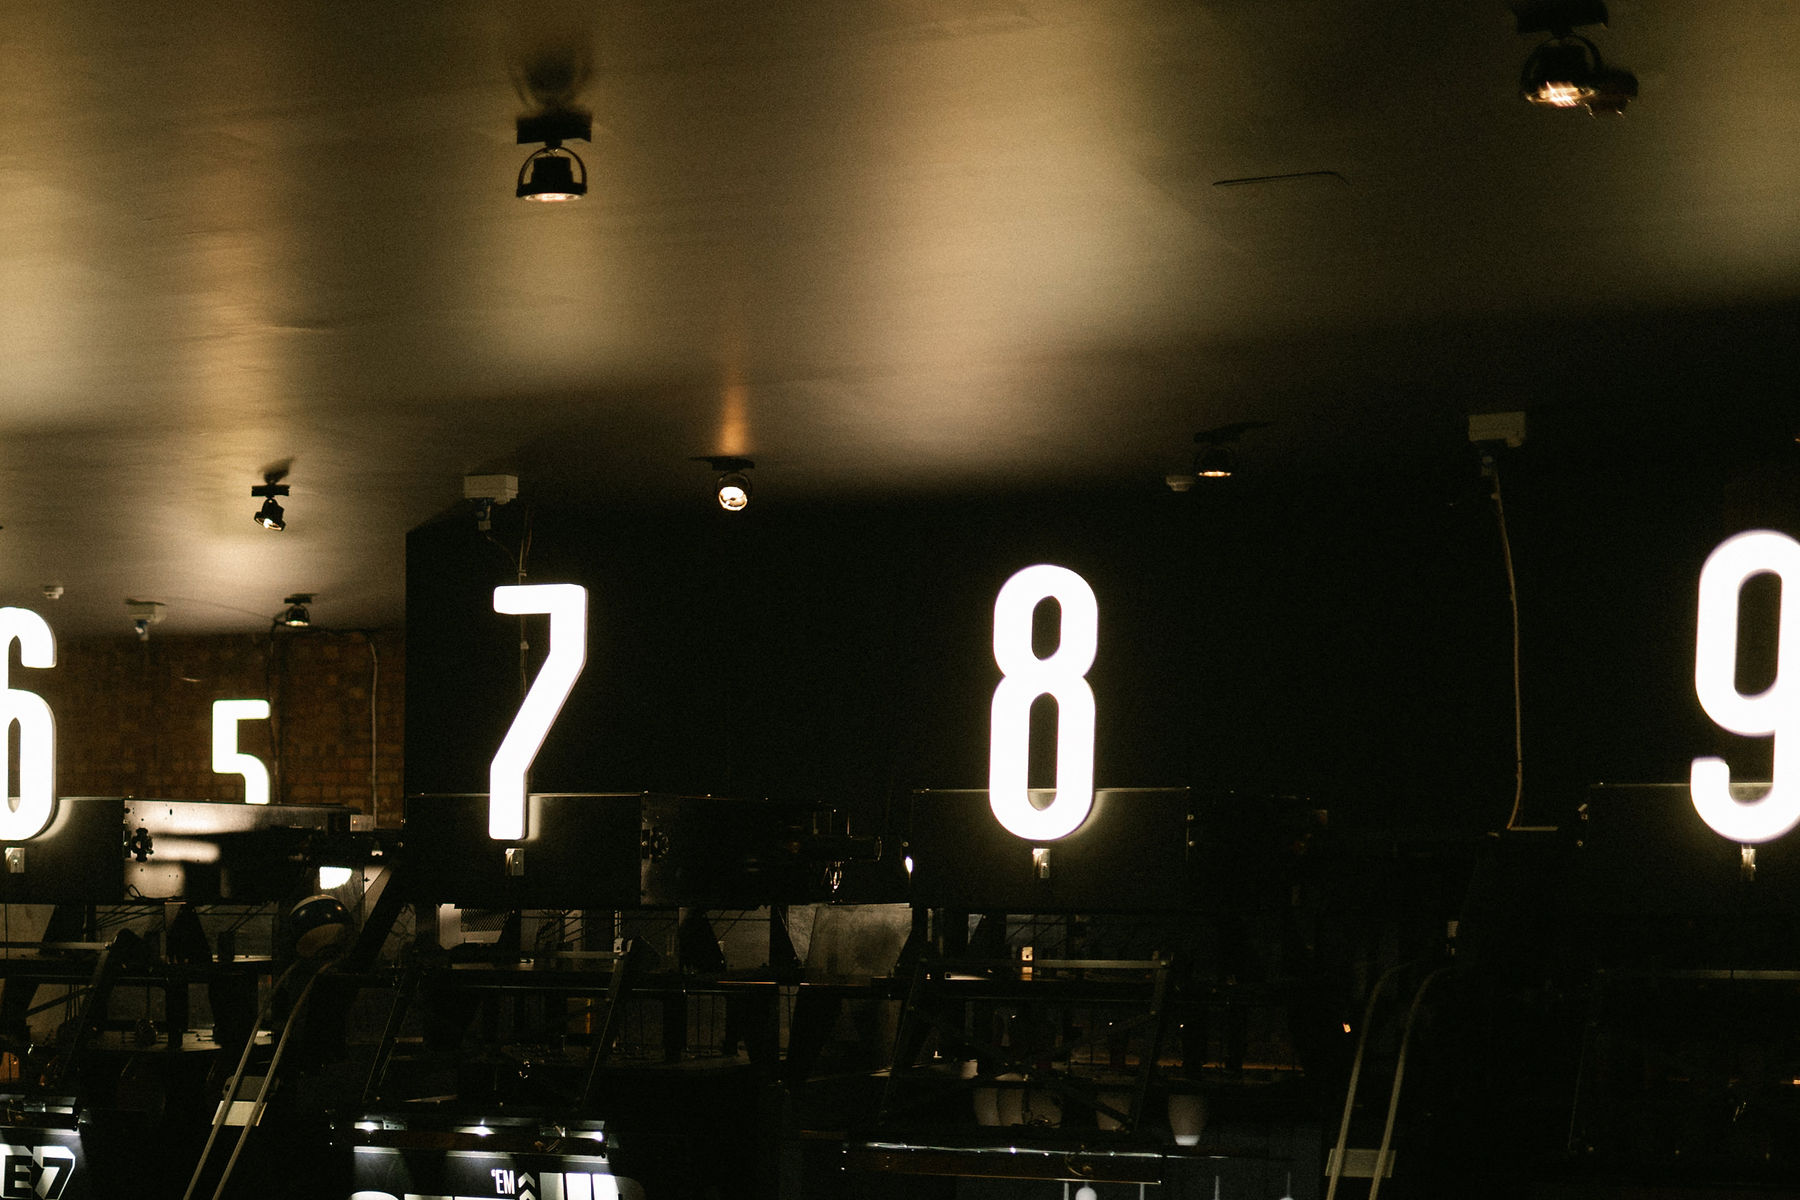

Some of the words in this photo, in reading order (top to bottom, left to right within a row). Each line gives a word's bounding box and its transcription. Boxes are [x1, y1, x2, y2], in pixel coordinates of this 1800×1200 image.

[212, 699, 271, 805] 5
[489, 583, 588, 841] 7
[989, 564, 1098, 842] 8
[1690, 530, 1800, 843] 9
